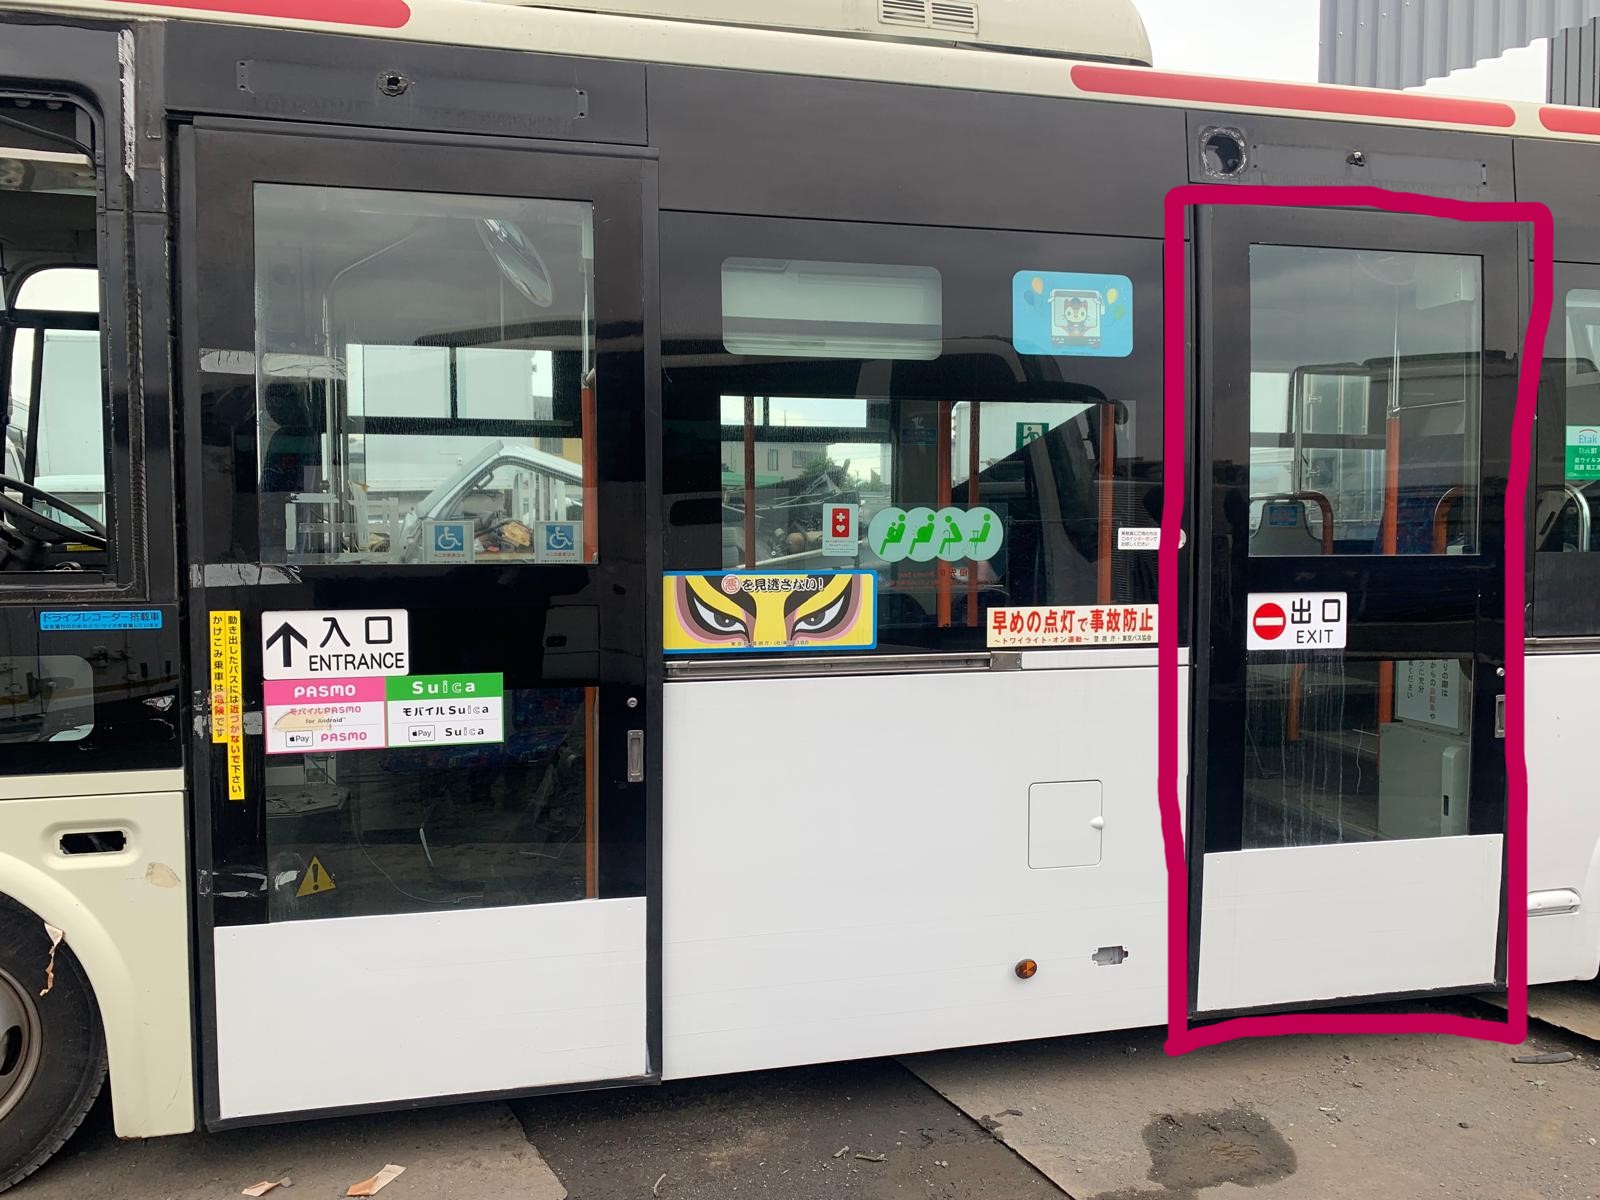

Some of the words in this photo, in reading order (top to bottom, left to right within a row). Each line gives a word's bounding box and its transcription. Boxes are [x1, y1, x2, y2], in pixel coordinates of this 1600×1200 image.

[43, 612, 159, 621] ドライブレコーダー搭載車
[1291, 597, 1340, 624] 出口
[992, 607, 1153, 635] 早めの点灯で事故防止
[319, 616, 392, 647] 入口
[1296, 629, 1334, 643] EXIT
[308, 652, 405, 671] ENTRANCE
[212, 615, 224, 737] かけこみ乗車は危険です
[293, 684, 356, 698] PASMO
[412, 680, 475, 694] Suica
[228, 615, 241, 792] 動き出したバスには近づかないで下さい
[289, 705, 361, 715] モバイルPASMO
[295, 734, 309, 743] Pay
[320, 731, 367, 742] PASMO
[418, 729, 431, 738] Pay
[445, 726, 484, 736] Suica
